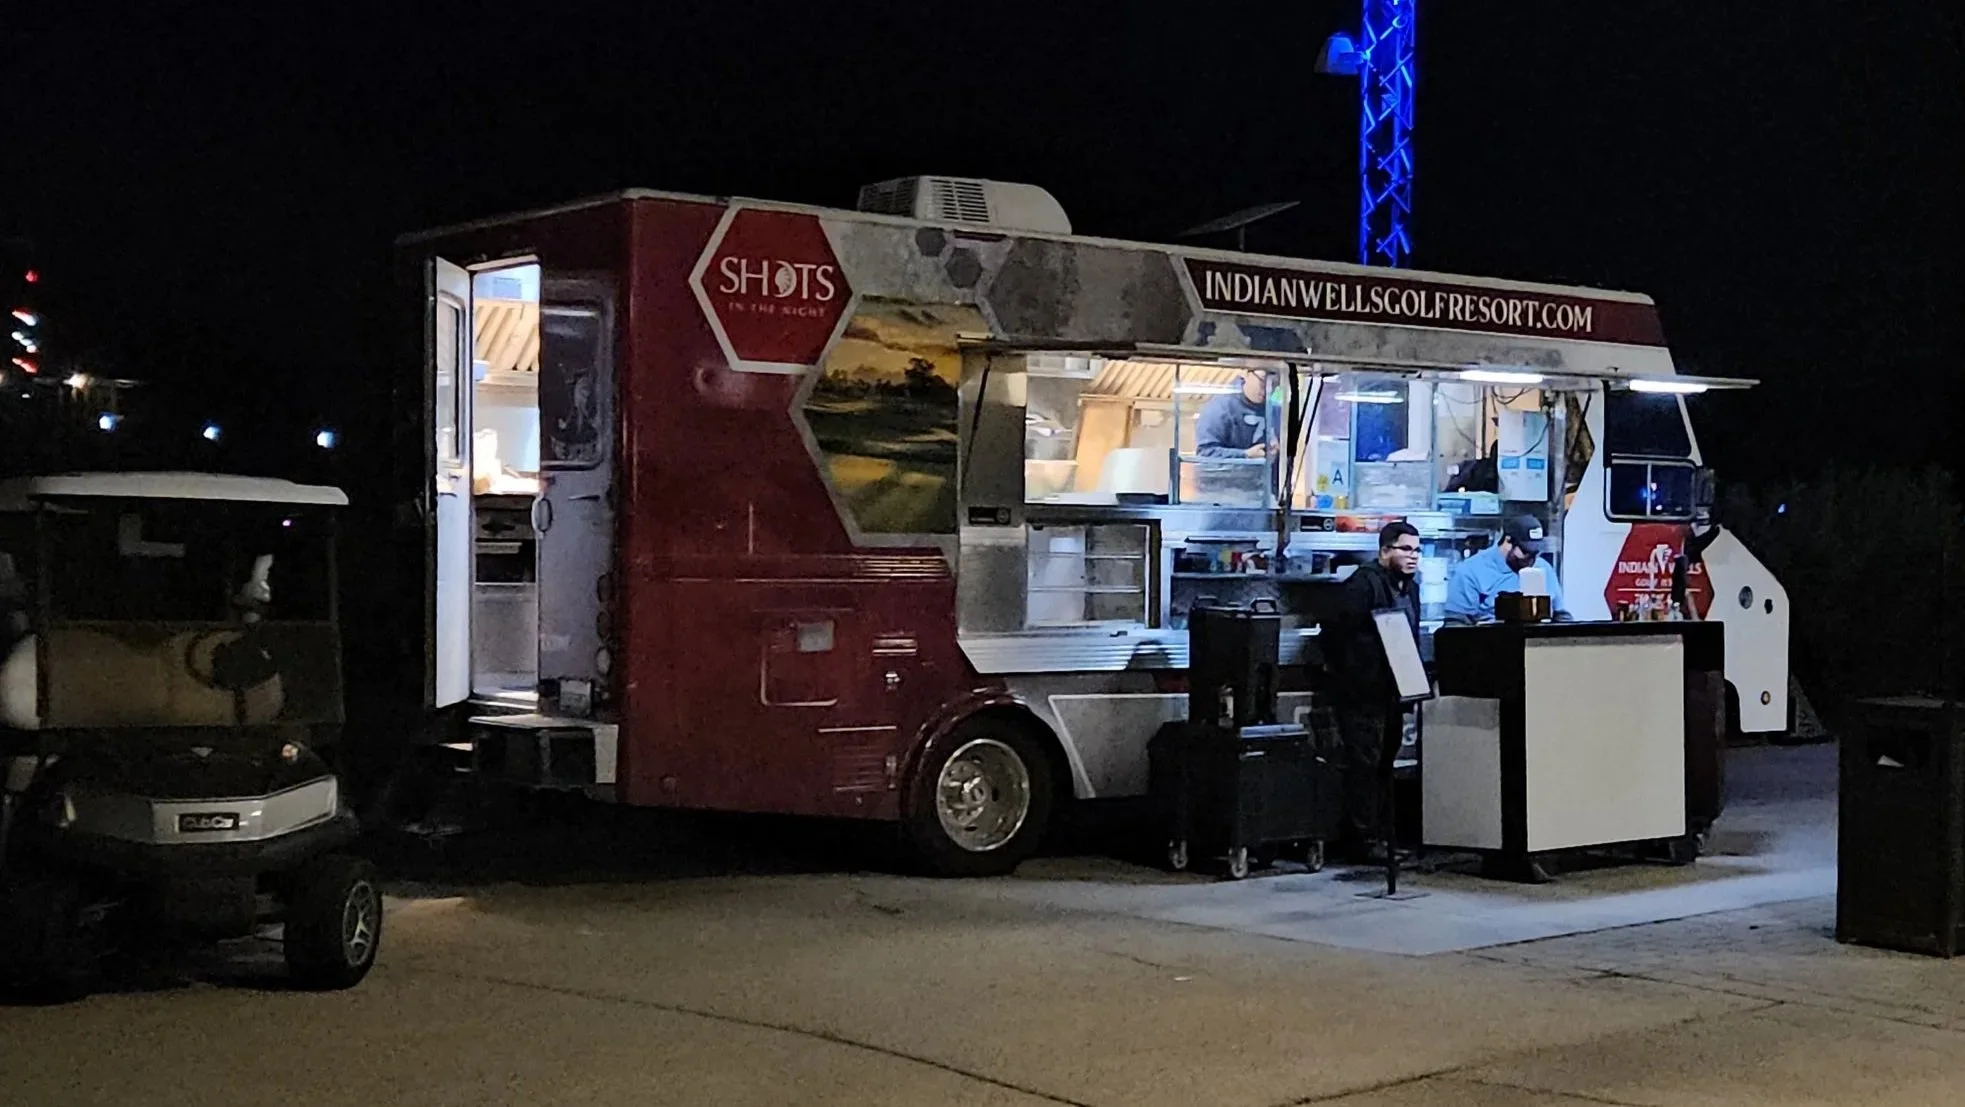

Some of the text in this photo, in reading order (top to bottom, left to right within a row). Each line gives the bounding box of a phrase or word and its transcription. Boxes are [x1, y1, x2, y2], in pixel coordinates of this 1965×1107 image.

[719, 256, 835, 301] SHOTS
[729, 302, 826, 318] IN THE NIGHT
[1205, 270, 1593, 333] INDIANWELLSGOLFRESORT.COM
[1332, 469, 1344, 485] A
